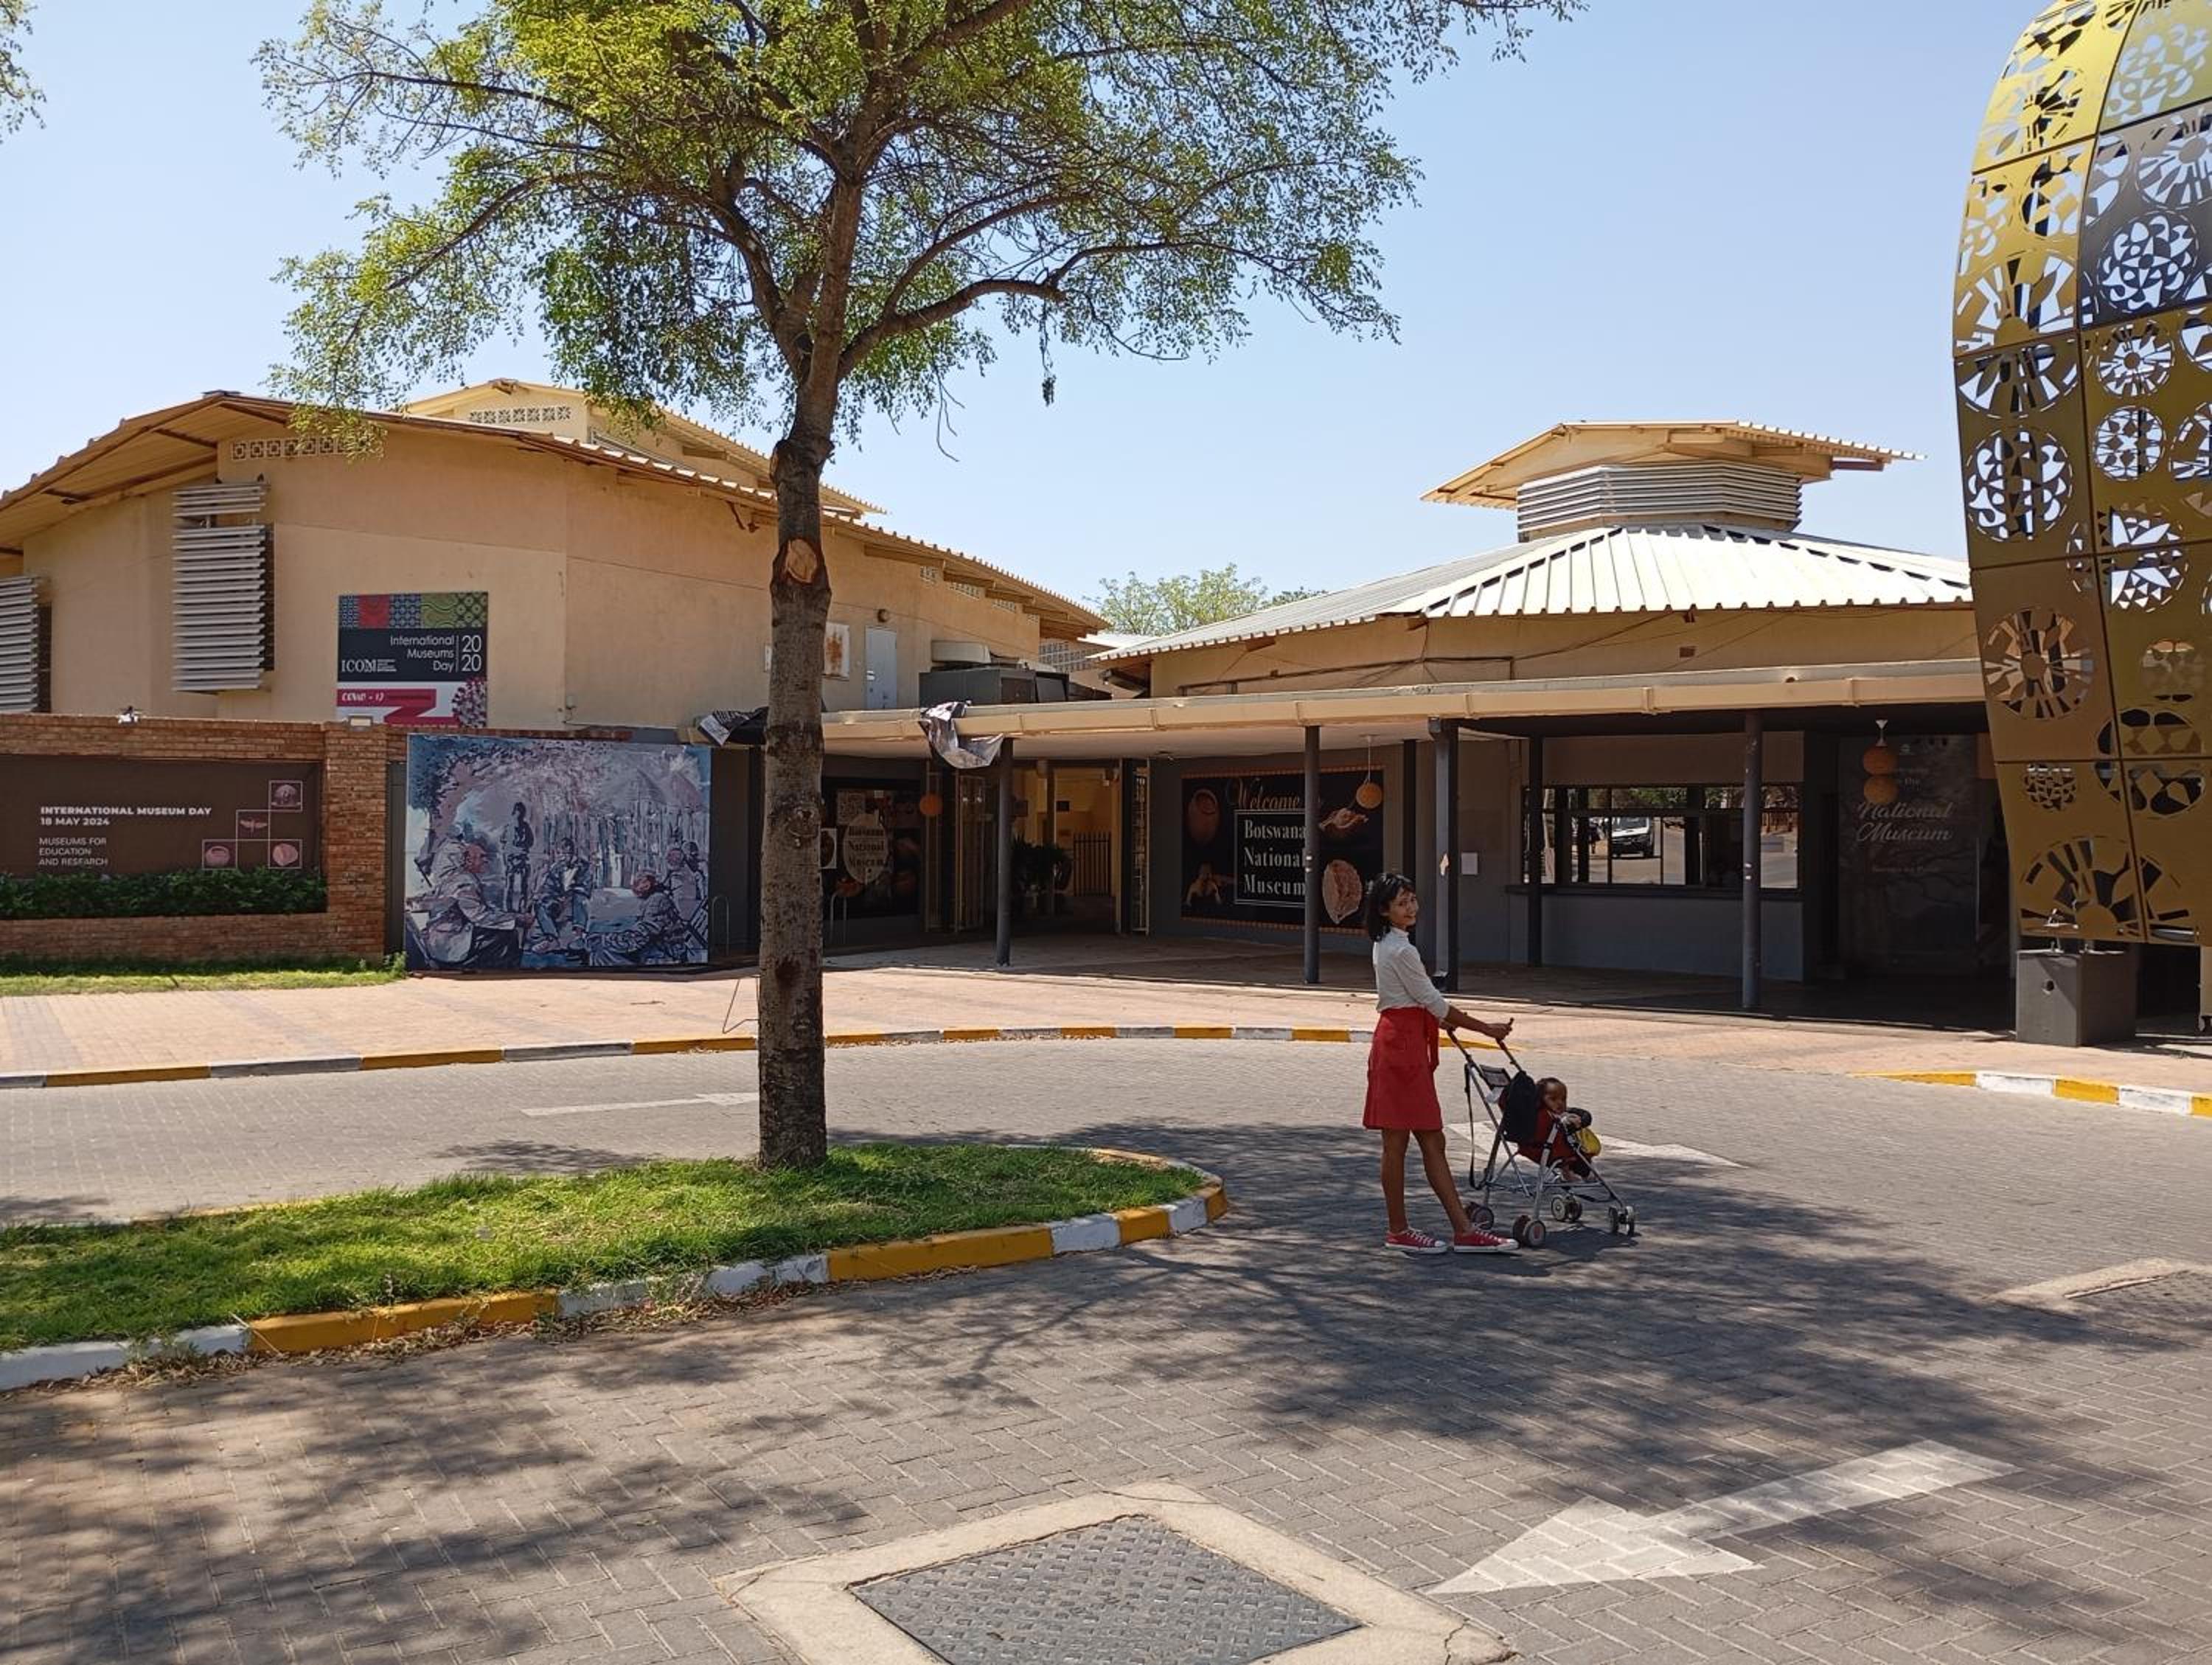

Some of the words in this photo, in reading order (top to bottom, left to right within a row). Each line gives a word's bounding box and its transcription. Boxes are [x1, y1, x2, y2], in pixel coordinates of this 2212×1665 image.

[390, 635, 454, 645] International
[462, 635, 481, 653] 20
[407, 649, 454, 658] Museums
[341, 659, 377, 672] ICOM
[434, 661, 454, 673] Day
[462, 654, 481, 672] 20
[1225, 776, 1300, 810] Welcome
[41, 806, 134, 815] INTERNATIONAL
[41, 817, 52, 825] 18
[55, 817, 80, 825] MAY
[1244, 819, 1307, 840] Botswana
[1856, 822, 1953, 842] Museum
[39, 838, 86, 846] MUSEUMS
[89, 838, 107, 846] FOR
[38, 858, 59, 866] AND
[61, 857, 108, 866] RESEARCH
[1244, 875, 1306, 894] Museum
